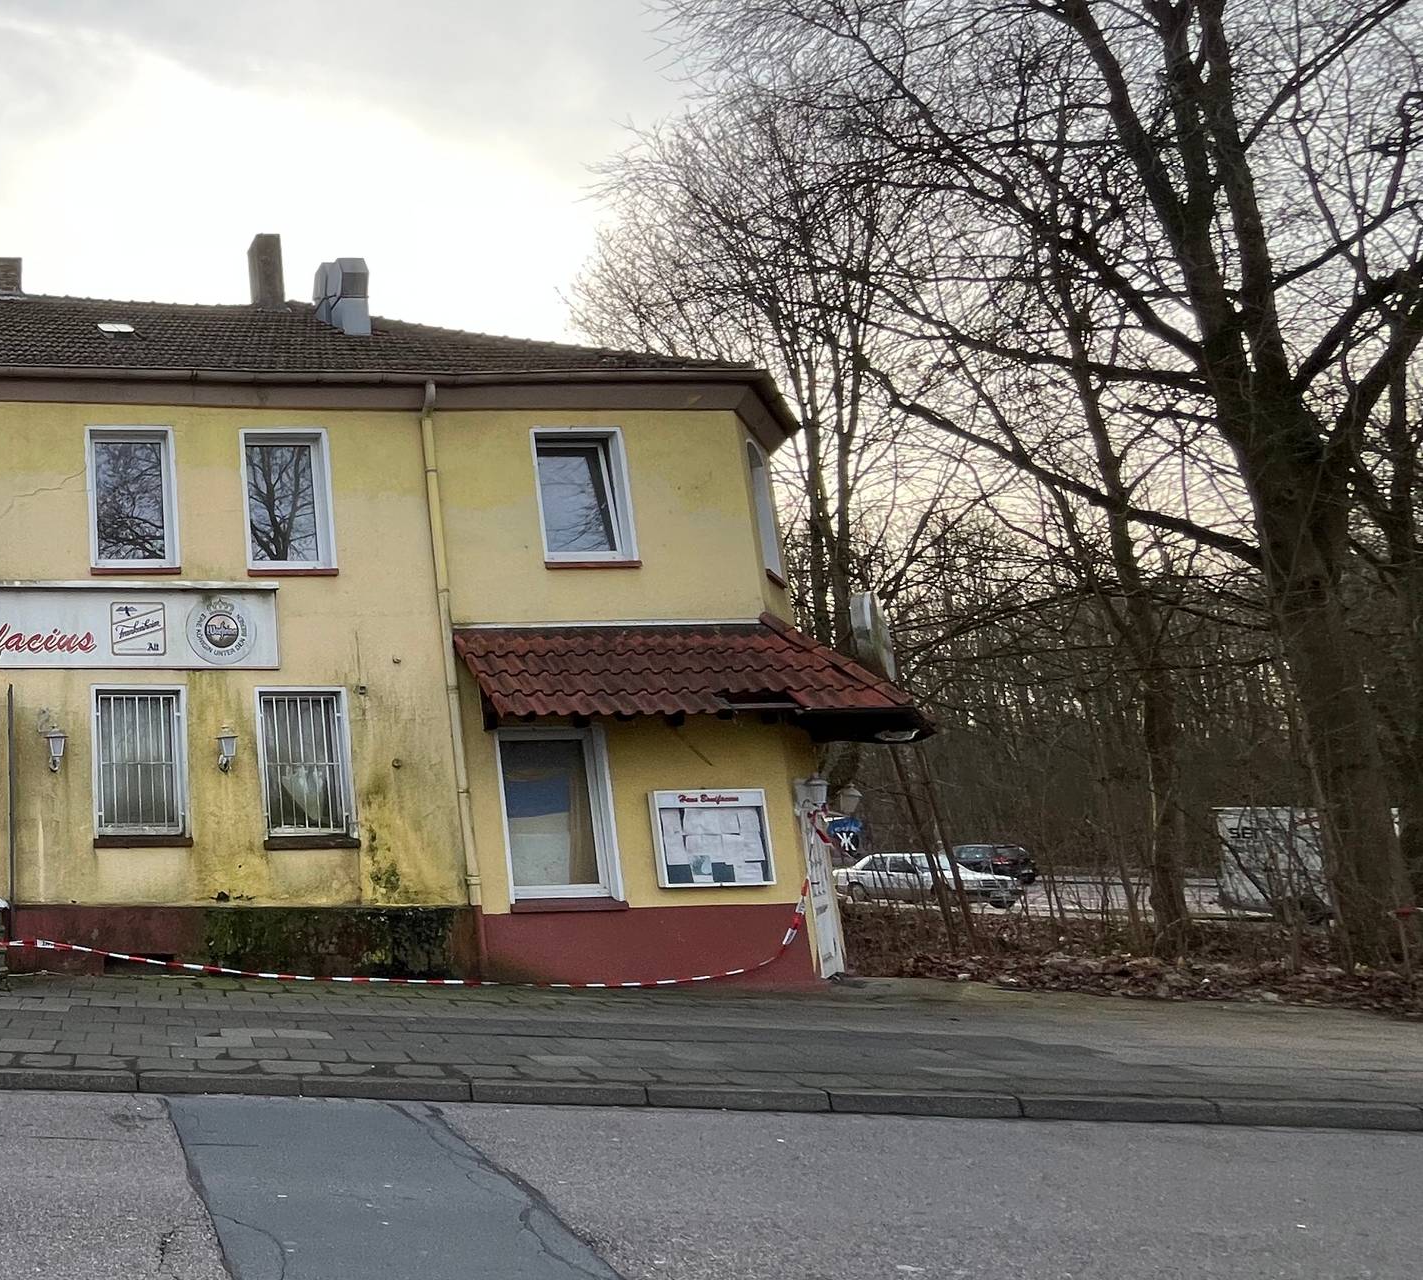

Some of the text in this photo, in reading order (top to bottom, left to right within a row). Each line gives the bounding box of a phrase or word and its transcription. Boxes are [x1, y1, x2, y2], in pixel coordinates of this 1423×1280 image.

[146, 642, 159, 651] Alt
[195, 613, 207, 628] EINE
[213, 648, 236, 657] UNTER
[234, 637, 246, 652] DEN
